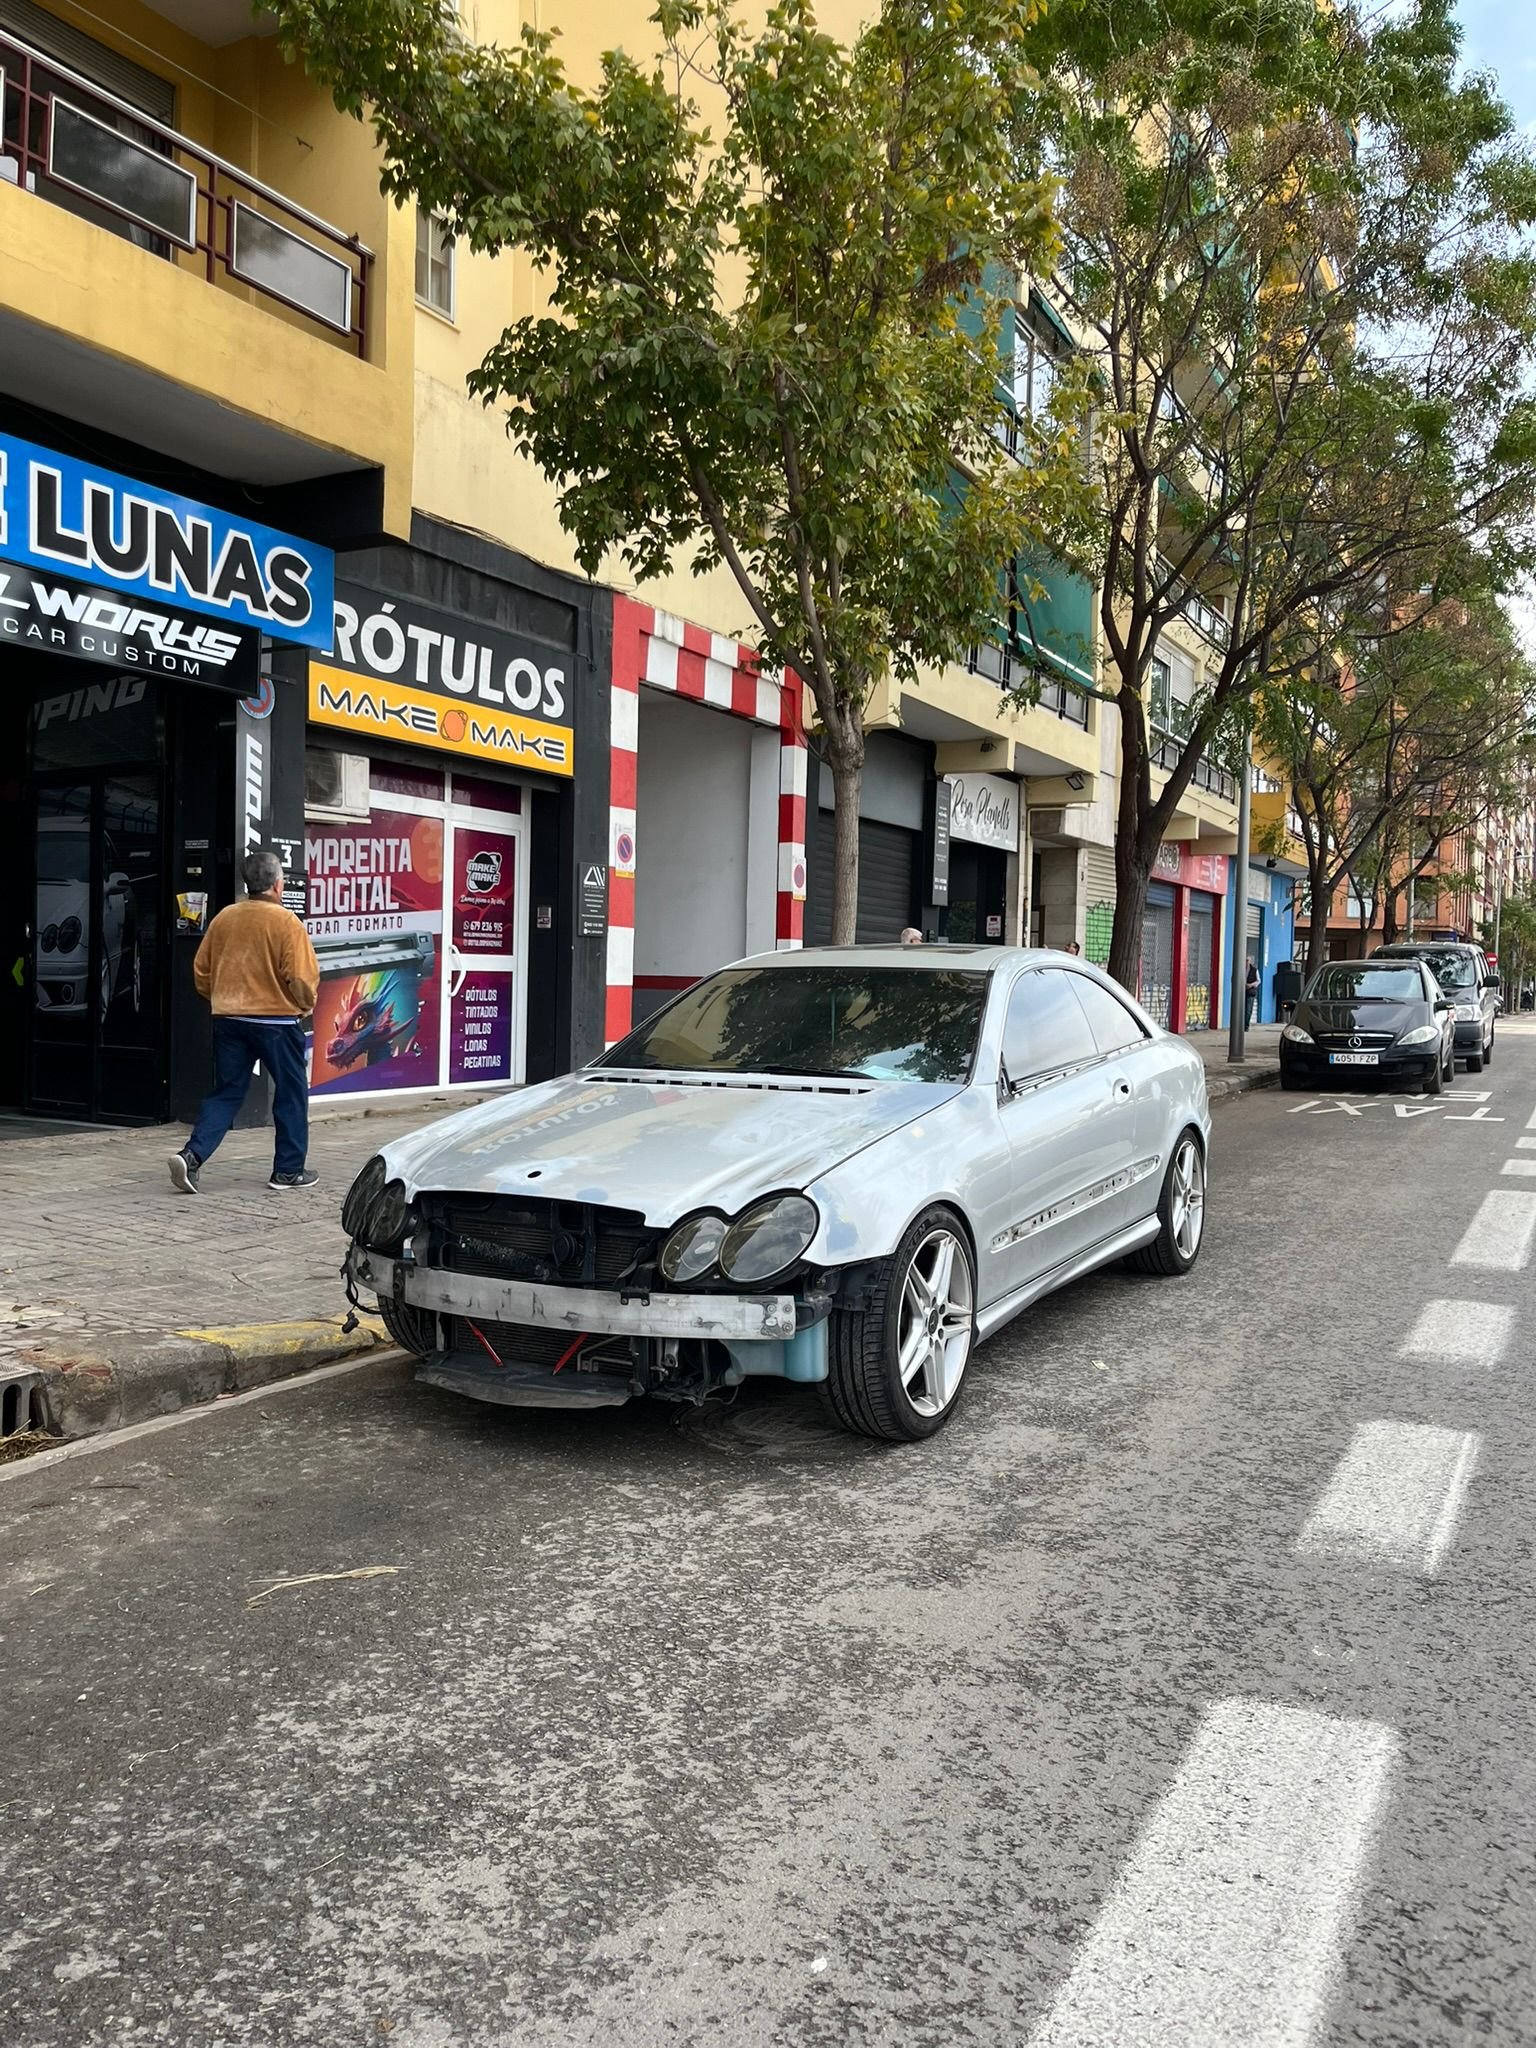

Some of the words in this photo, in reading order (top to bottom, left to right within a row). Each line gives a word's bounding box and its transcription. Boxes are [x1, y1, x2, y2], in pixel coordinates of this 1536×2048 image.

[29, 460, 312, 627] LUNAS
[3, 616, 67, 646] CAR
[80, 636, 201, 677] CUSTOM
[321, 601, 565, 718] RÓTULOS
[33, 674, 148, 731] PING
[319, 682, 438, 734] MAKE
[471, 720, 566, 762] MAKE
[281, 844, 293, 869] 3
[468, 862, 497, 874] MAKE
[471, 872, 500, 883] MAKE
[310, 876, 400, 915] DIGITAL
[307, 919, 340, 935] GRAN
[348, 915, 403, 933] FORMATO
[465, 986, 498, 1001] RÓTULOS
[465, 1006, 498, 1018] TINTADOS
[464, 1023, 492, 1035] VINILOS
[464, 1039, 488, 1052] LONAS
[463, 1055, 502, 1069] PEGATINAS
[1286, 1100, 1505, 1122] TAXI
